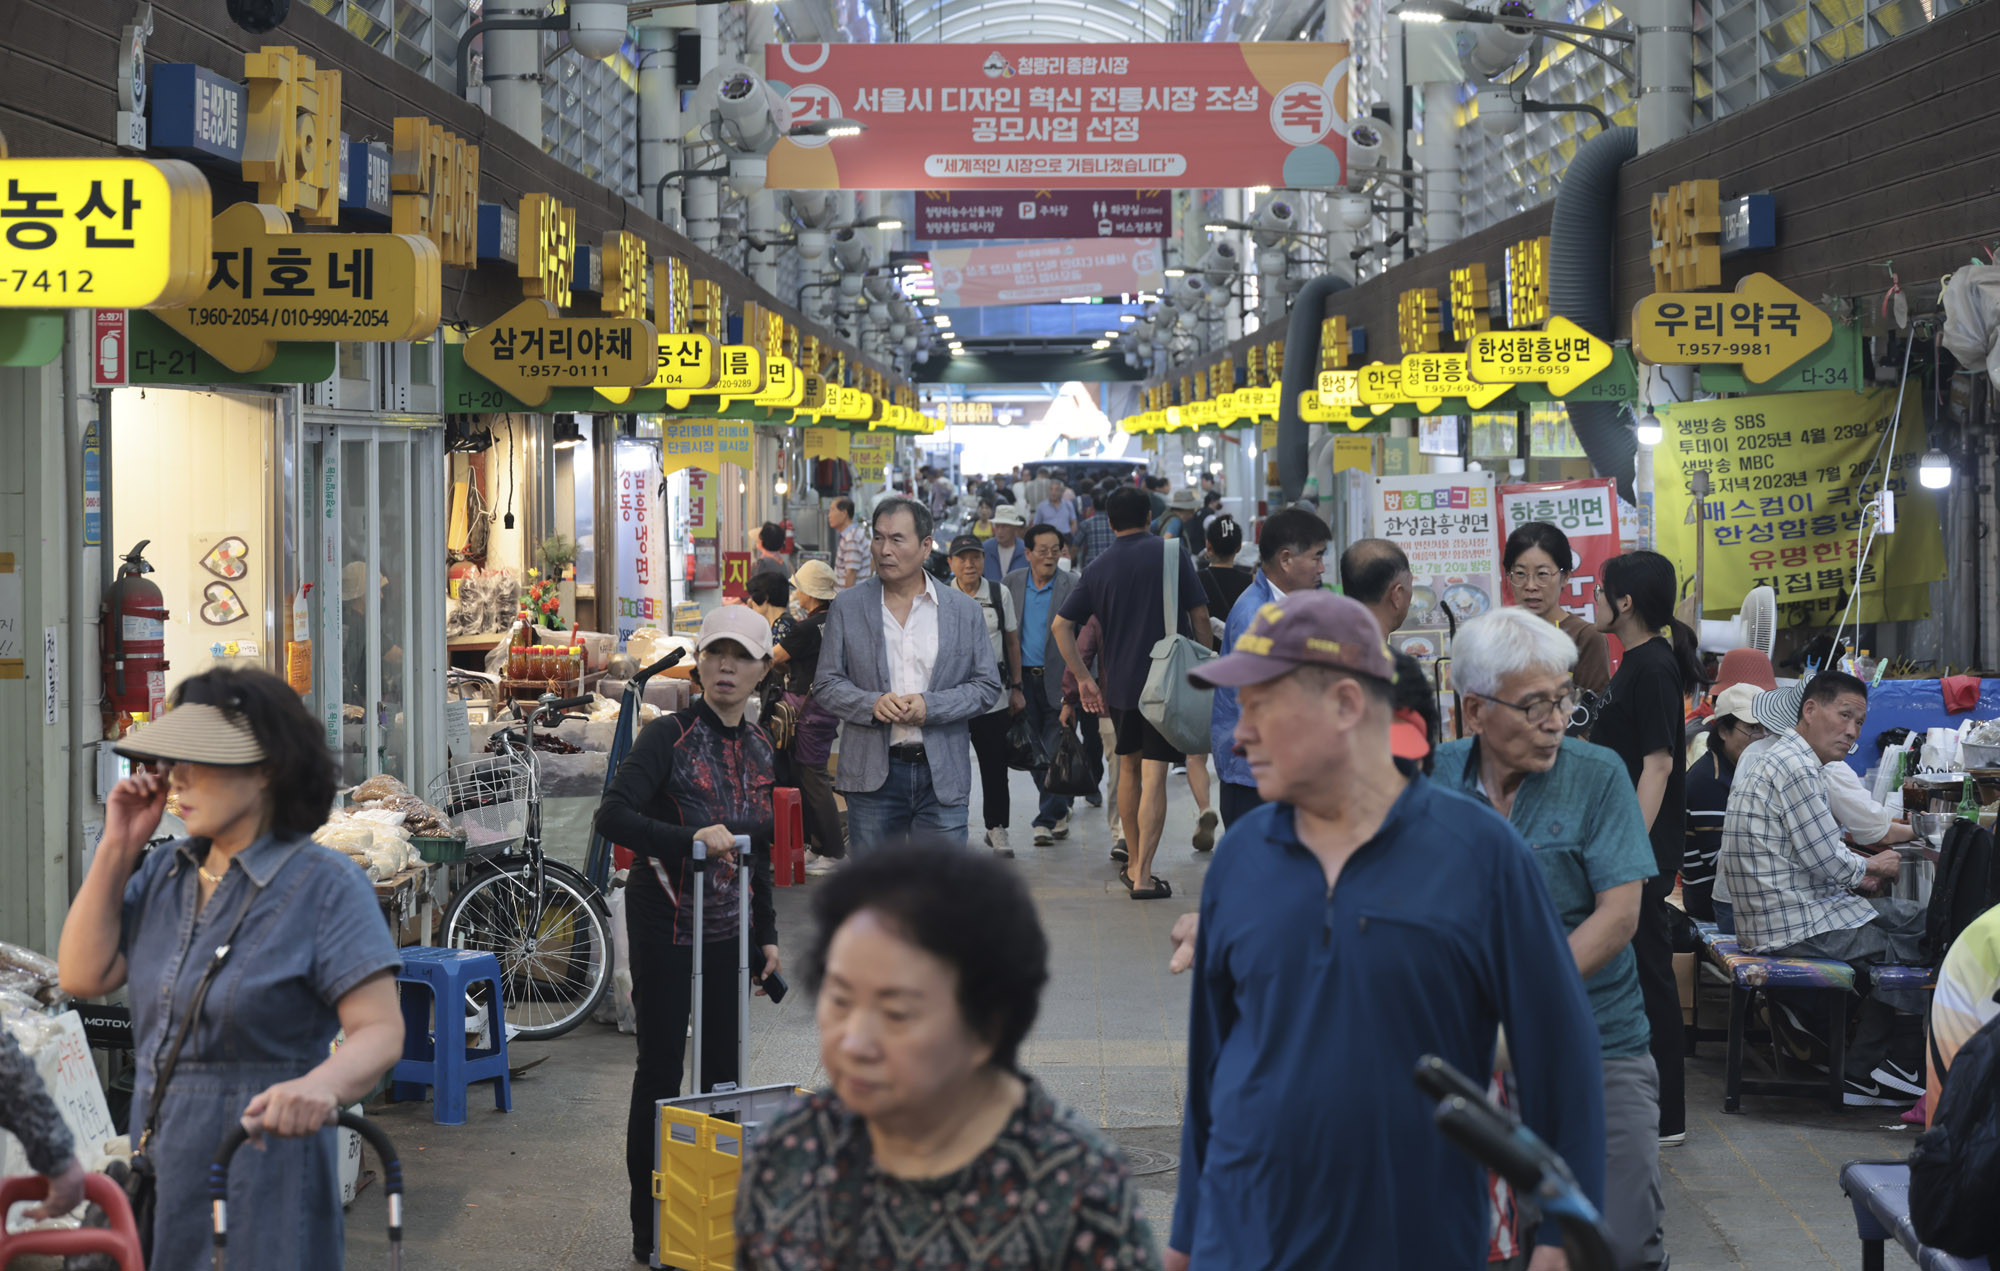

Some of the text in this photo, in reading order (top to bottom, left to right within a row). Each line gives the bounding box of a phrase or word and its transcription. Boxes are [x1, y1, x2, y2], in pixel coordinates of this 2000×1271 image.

[1018, 56, 1129, 76] 청량리 종합시장
[853, 86, 1259, 113] 서울시 디자인 혁신 전통시장 조성
[1281, 92, 1324, 134] 축
[972, 117, 1140, 142] 공모사업 선정
[936, 157, 1175, 174] "세계적인 시장으로 거듭나겠습니다"
[1, 179, 142, 250] 농산
[1040, 205, 1069, 217] 주차장
[1111, 204, 1140, 216] 화장실
[1115, 222, 1163, 234] 버스정류장
[207, 247, 374, 301] 지호네
[98, 313, 123, 322] 소화기
[189, 307, 269, 327] T.960-2054
[281, 307, 389, 327] 010-9904-2054
[1655, 302, 1801, 337] 우리약국
[490, 327, 632, 361] 삼거리야채
[1478, 337, 1591, 364] 한성함흥냉면
[1677, 343, 1771, 357] T.957-9981
[135, 349, 197, 375] 다-21
[518, 365, 609, 378] T.957-0111
[1422, 358, 1470, 383] 함흥
[769, 364, 785, 383] 면
[1321, 374, 1346, 393] 한성
[1801, 367, 1849, 385] 다-34
[458, 391, 503, 408] 다-20
[1591, 384, 1627, 397] 다-35
[667, 424, 714, 438] 우리동네
[1677, 413, 1766, 435] 생방송 SBS
[1679, 437, 1729, 455] 투데이
[1737, 431, 1792, 452] 2025년
[1800, 427, 1826, 444] 4월
[1834, 423, 1869, 441] 23일
[1681, 454, 1775, 477] 생방송 MBC
[1753, 470, 1807, 491] 2023년
[1816, 466, 1841, 483] 7월
[1702, 494, 1813, 521] 매스컴이
[1384, 512, 1490, 537] 한성함흥냉면
[1749, 537, 1875, 572] 유명한집
[84, 1016, 133, 1029] MOTOV
